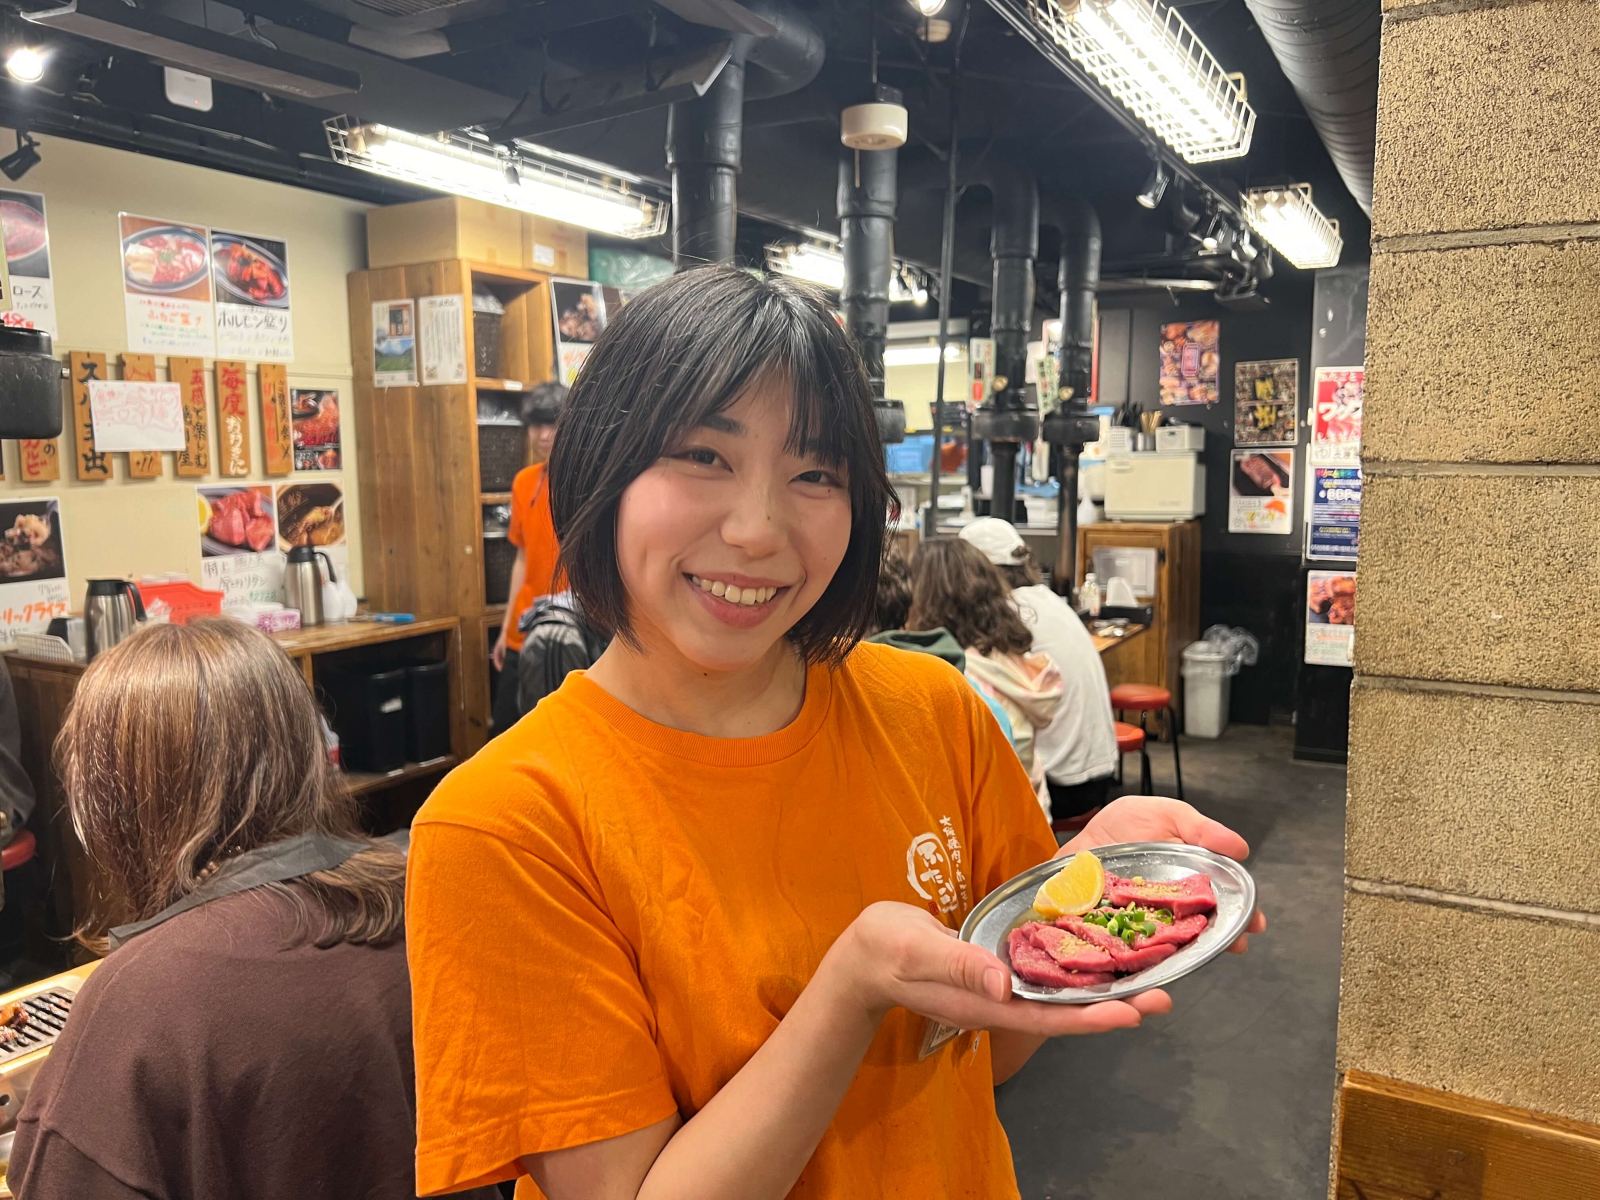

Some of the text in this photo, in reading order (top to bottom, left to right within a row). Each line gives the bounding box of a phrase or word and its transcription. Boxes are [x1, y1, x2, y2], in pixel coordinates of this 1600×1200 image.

[217, 310, 288, 333] ホルモン盛り
